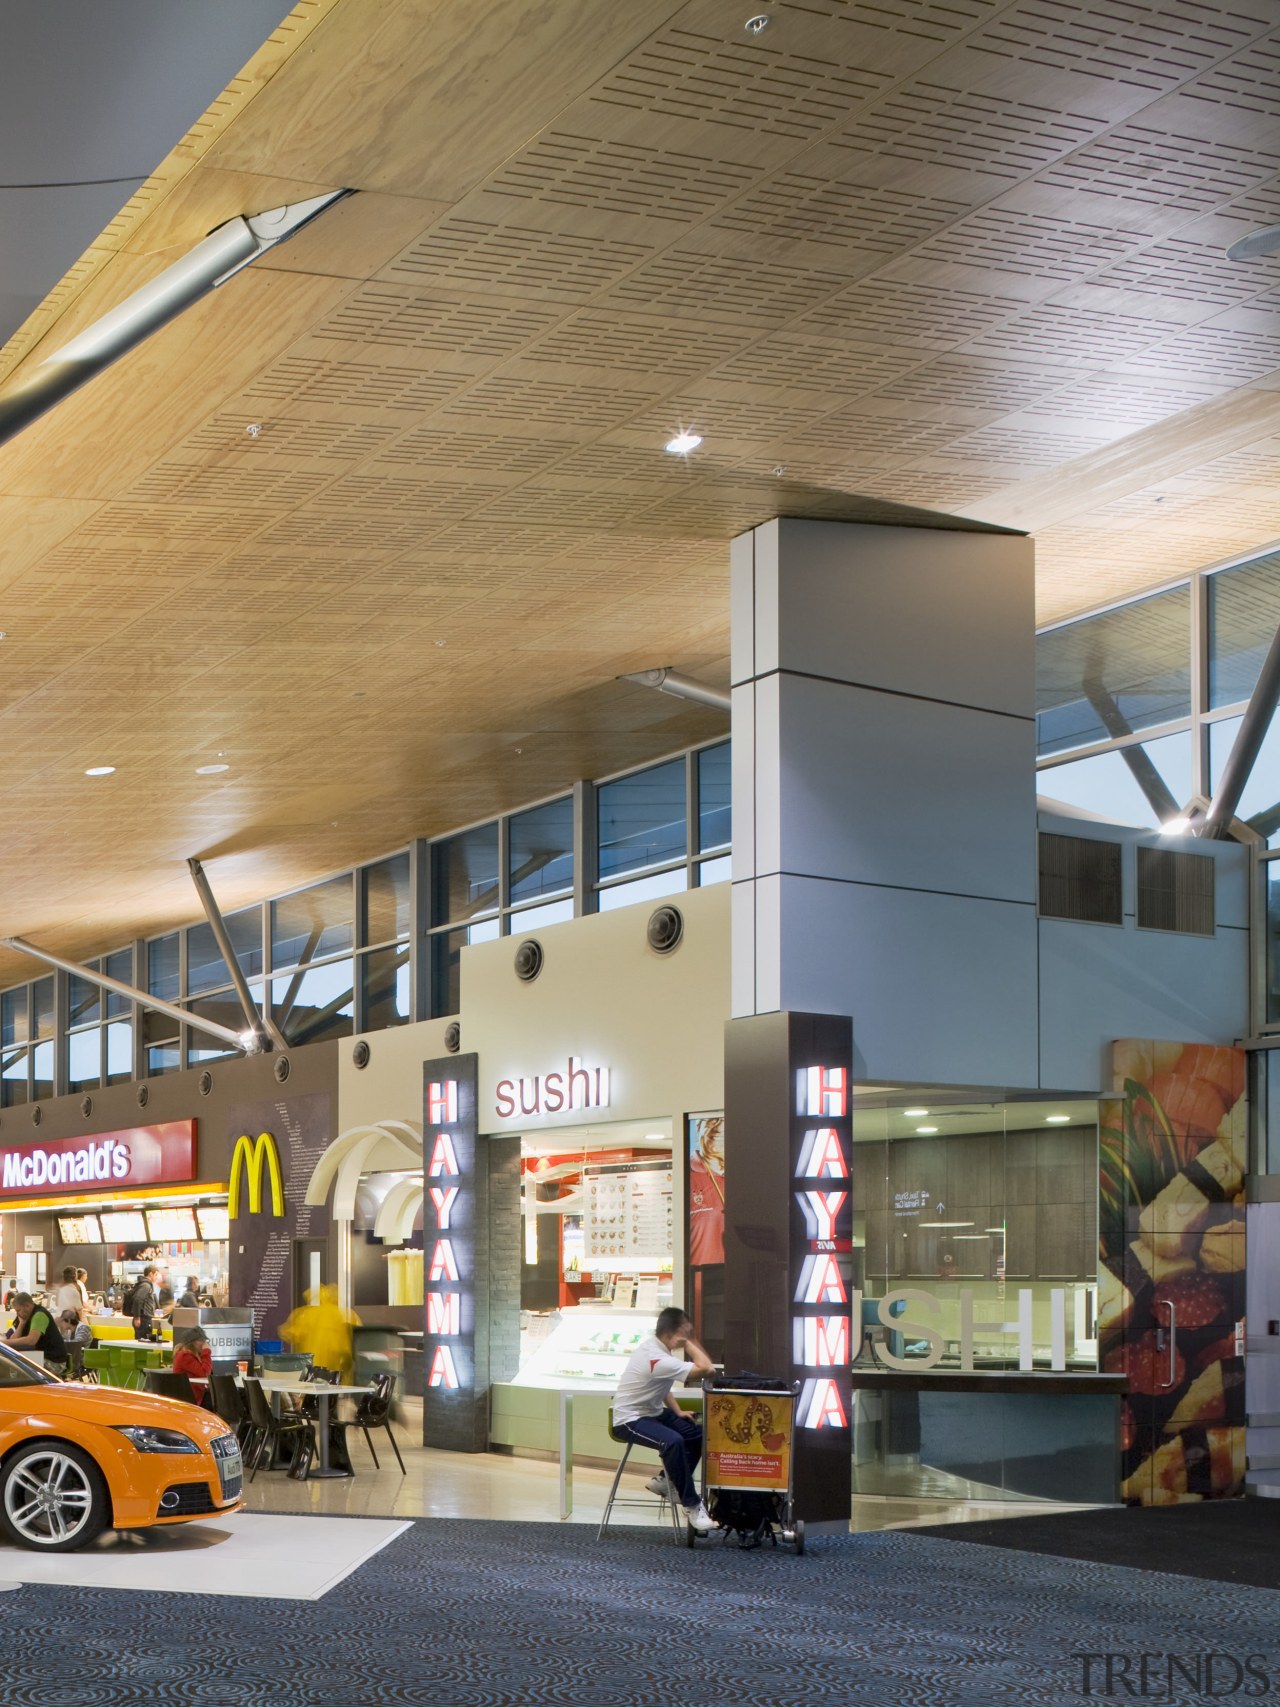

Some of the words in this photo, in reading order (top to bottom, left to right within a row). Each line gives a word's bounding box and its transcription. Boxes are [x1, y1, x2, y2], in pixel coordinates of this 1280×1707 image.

[495, 1056, 609, 1118] sushi
[2, 1140, 130, 1188] McDonald's
[426, 1080, 460, 1388] HAYAMA
[793, 1065, 848, 1428] HAYAMA
[852, 1288, 1065, 1371] SHI
